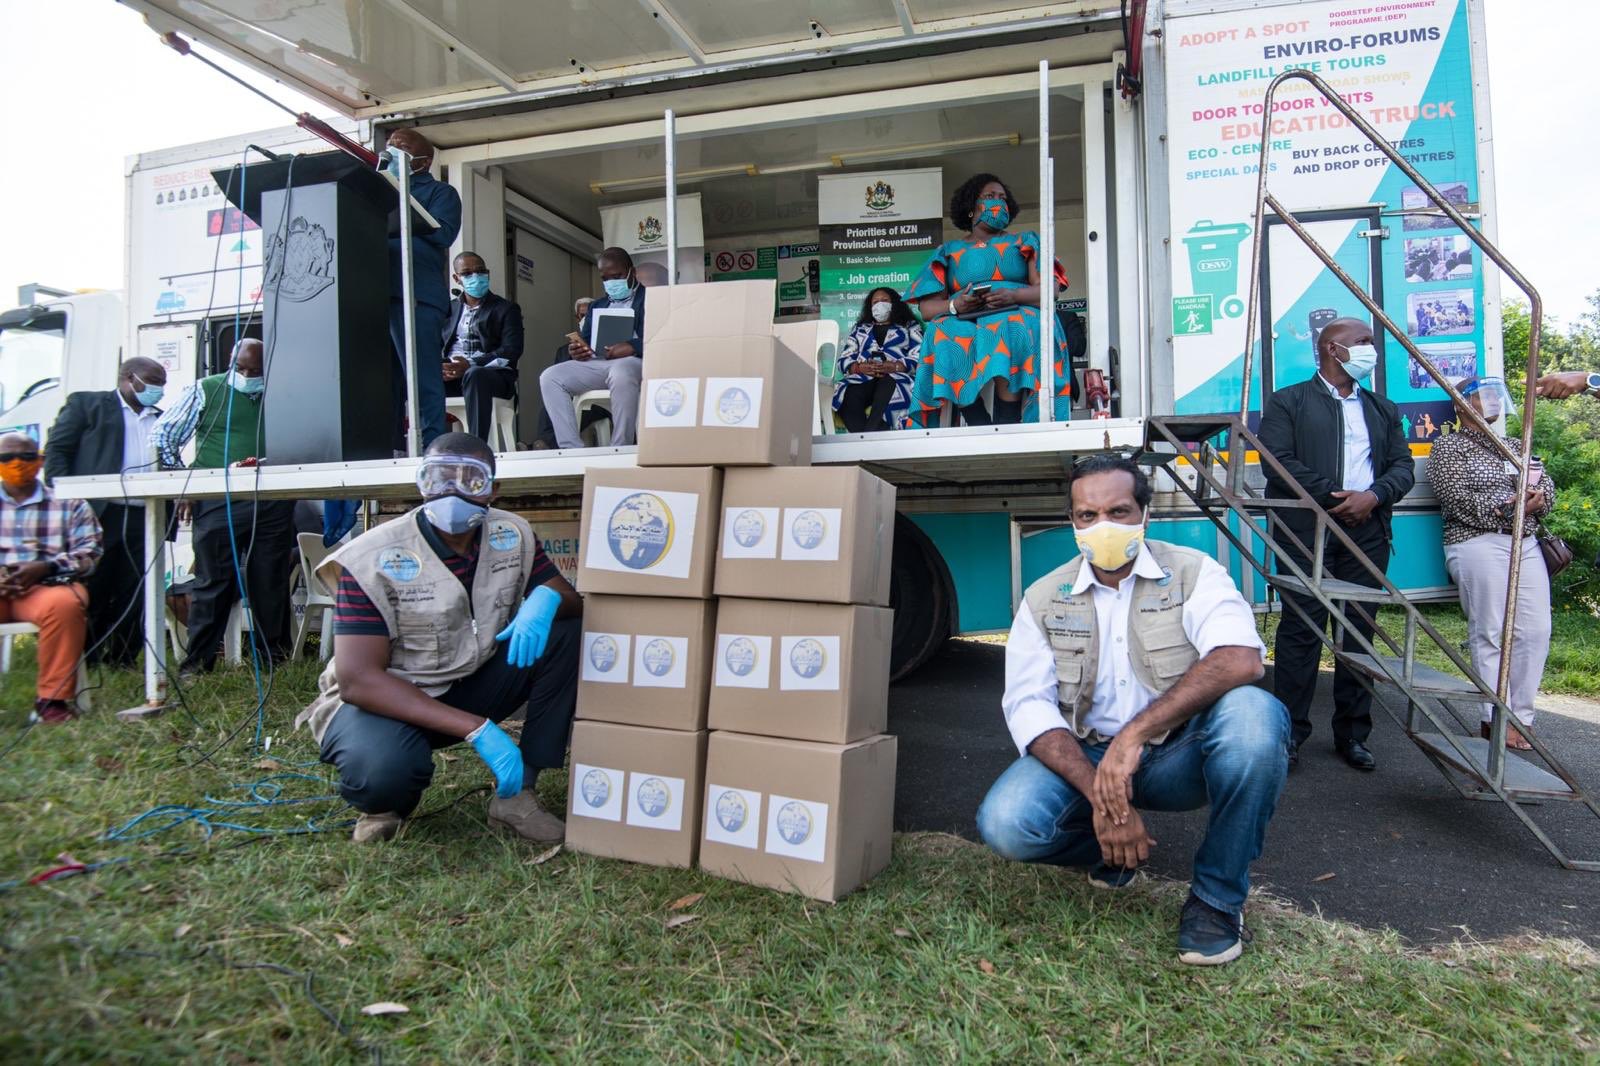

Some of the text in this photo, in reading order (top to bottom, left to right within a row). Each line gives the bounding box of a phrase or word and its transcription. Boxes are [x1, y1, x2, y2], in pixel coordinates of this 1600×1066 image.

[1329, 1, 1436, 18] DOORSTEP ENVIRONMENT
[1329, 13, 1407, 27] PROGRAMME (DEP)
[1179, 20, 1310, 47] ADOPT A SPOT
[1263, 26, 1441, 59] ENVIRO-FORUMS
[1197, 65, 1277, 86] LANDFILL
[1327, 54, 1387, 71] TOURS
[1363, 71, 1411, 85] SHOWS
[1192, 106, 1237, 121] DOOR
[1241, 103, 1264, 116] TO
[1320, 91, 1374, 107] VSITS
[1369, 101, 1456, 125] TRUCK
[1188, 147, 1218, 161] ECO
[1231, 139, 1293, 156] CENRE
[1292, 138, 1425, 159] BUY BACK CETRES
[1186, 162, 1278, 180] SPECIAL DAS
[1293, 150, 1455, 175] AND DROP OFF ENTRES
[846, 224, 918, 238] Priorities of KZN
[832, 235, 932, 250] Provincial Government
[839, 255, 891, 265] 1. Basic Services
[846, 274, 865, 285] Job
[867, 271, 910, 284] creation
[1060, 301, 1086, 310] DSW
[544, 538, 570, 554] AGE
